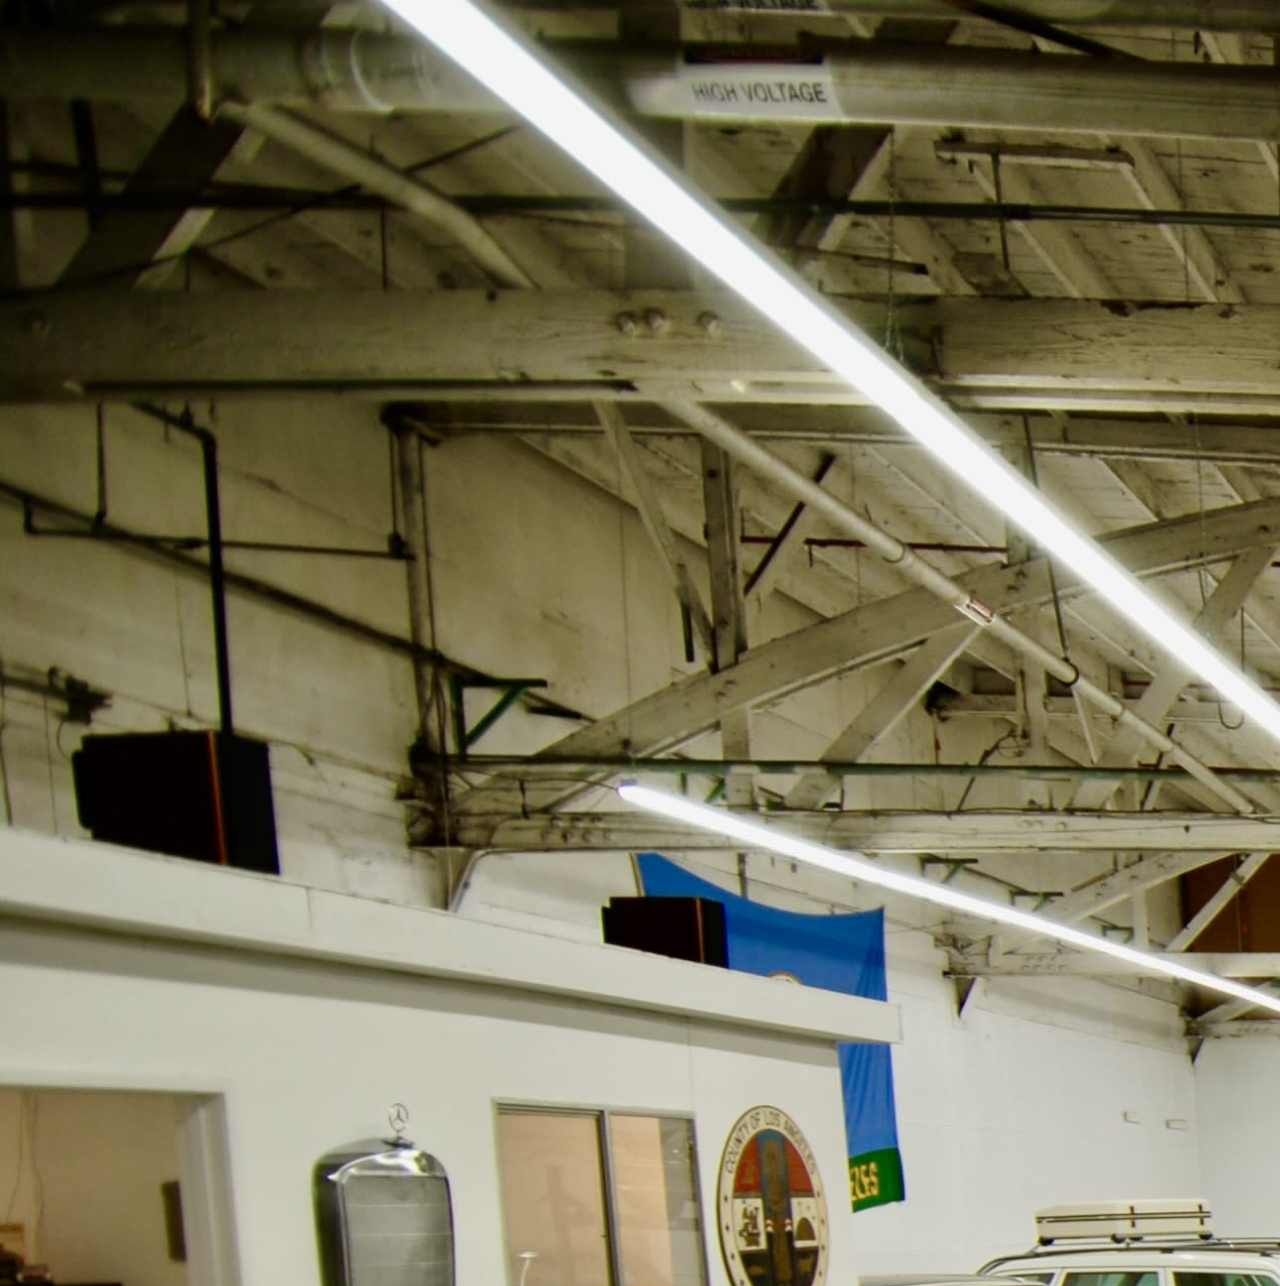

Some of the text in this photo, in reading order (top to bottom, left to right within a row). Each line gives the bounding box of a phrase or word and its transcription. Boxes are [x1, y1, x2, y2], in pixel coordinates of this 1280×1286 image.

[690, 79, 828, 103] HIGH VOLTAGE
[725, 1123, 750, 1174] COUNTY
[763, 1110, 781, 1127] LOS
